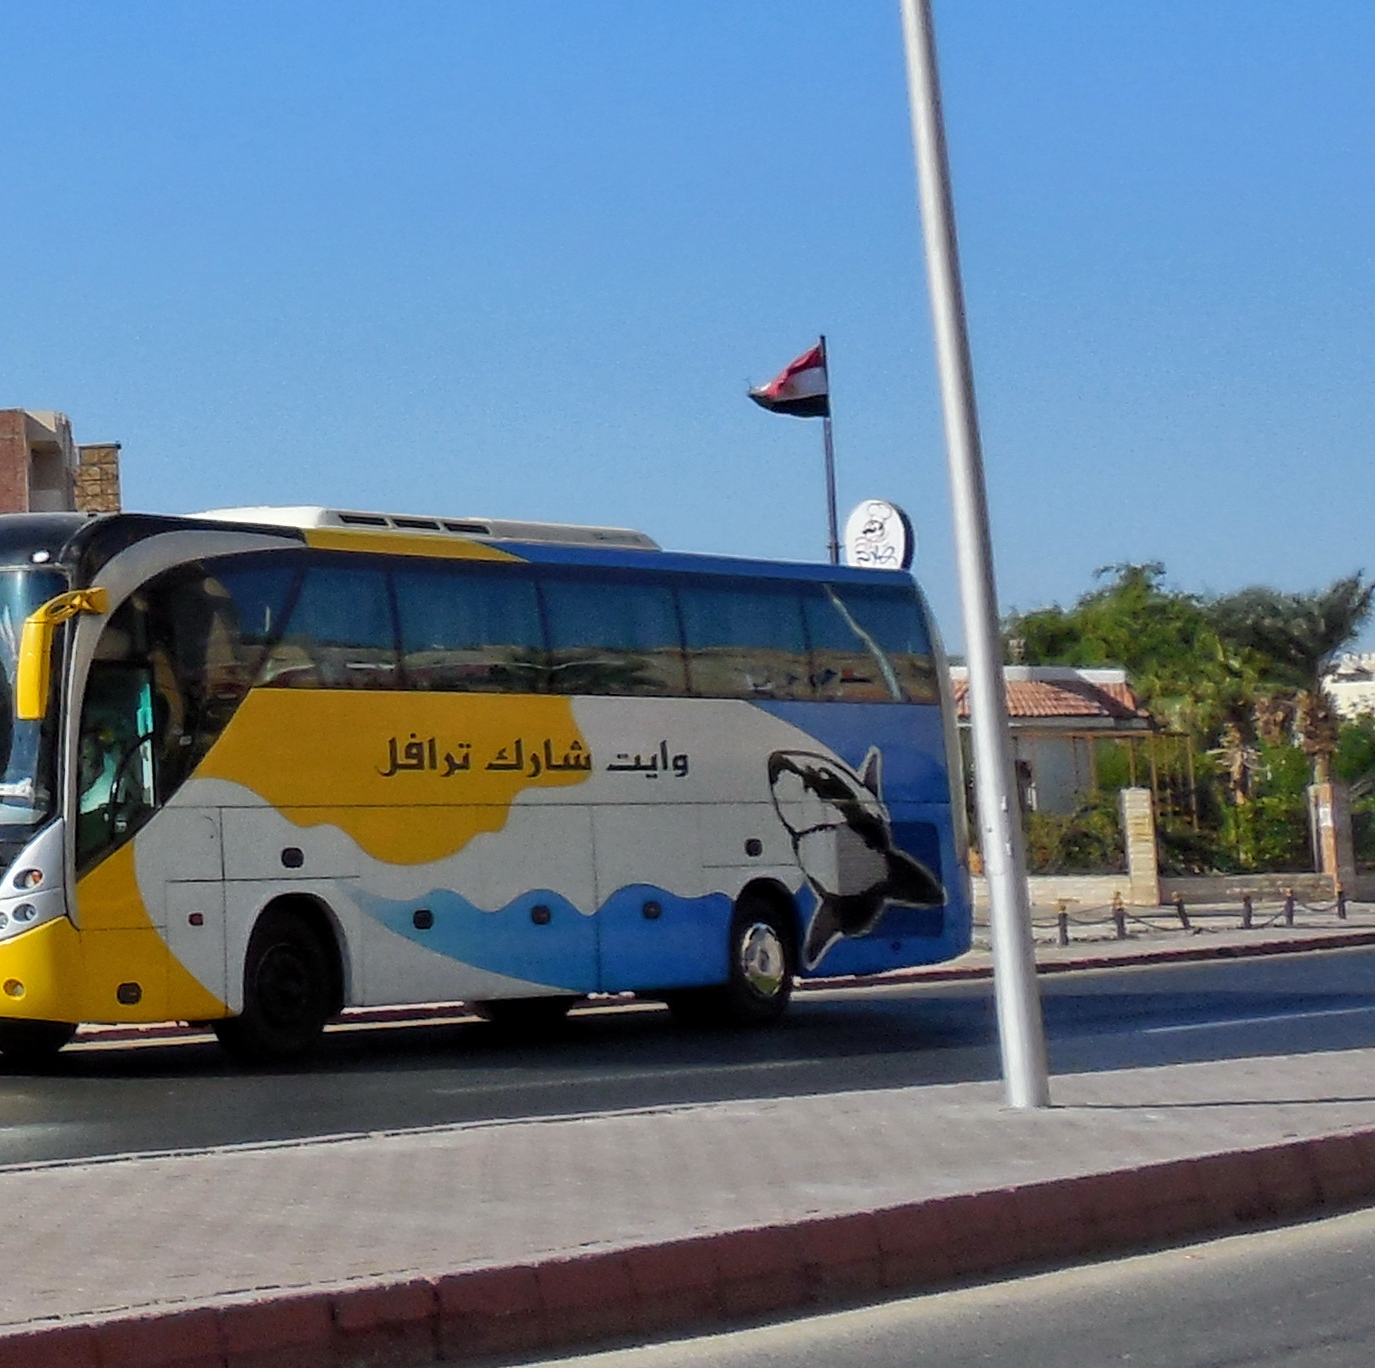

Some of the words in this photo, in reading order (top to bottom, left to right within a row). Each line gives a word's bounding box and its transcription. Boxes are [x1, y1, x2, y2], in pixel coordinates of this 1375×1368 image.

[375, 732, 473, 778] ترافل
[484, 737, 593, 779] شارك
[606, 739, 690, 779] وايت
